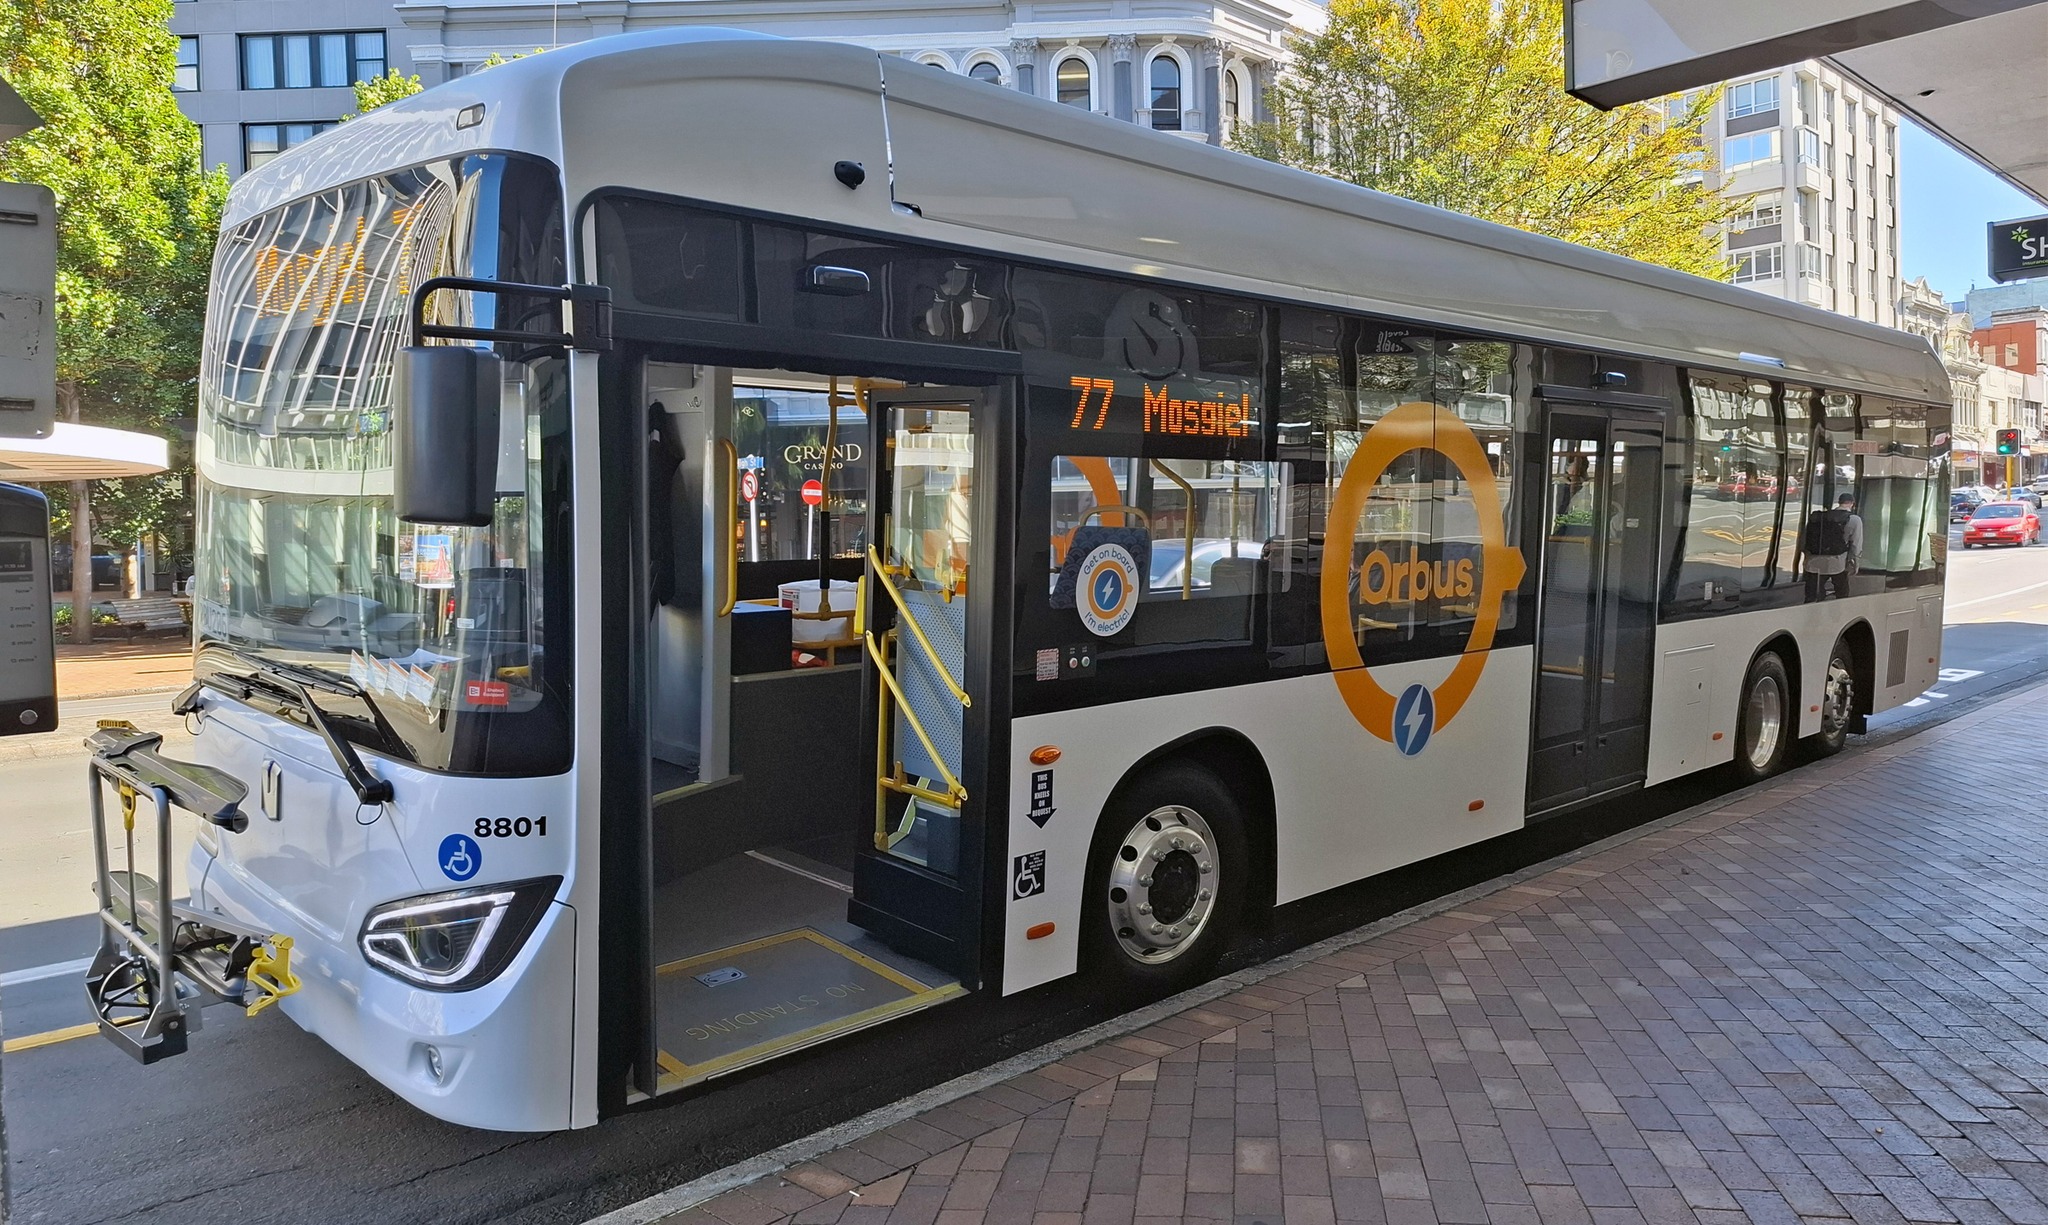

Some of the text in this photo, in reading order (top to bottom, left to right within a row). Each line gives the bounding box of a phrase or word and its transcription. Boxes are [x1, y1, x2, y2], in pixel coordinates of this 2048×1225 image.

[1070, 376, 1249, 437] 77 Mosgiel
[784, 443, 862, 464] GRAND
[804, 462, 844, 471] CASNO
[1083, 547, 1135, 575] Get on board
[1361, 545, 1474, 605] Orbus
[1084, 609, 1131, 632] I'm electric!
[1037, 773, 1048, 783] THIS
[1037, 782, 1047, 791] BUS
[1034, 790, 1050, 800] KNEELS
[1038, 799, 1046, 808] ON
[1031, 806, 1052, 818] REQUEST
[474, 815, 547, 838] 8801
[685, 981, 866, 1041] NO STANDING
